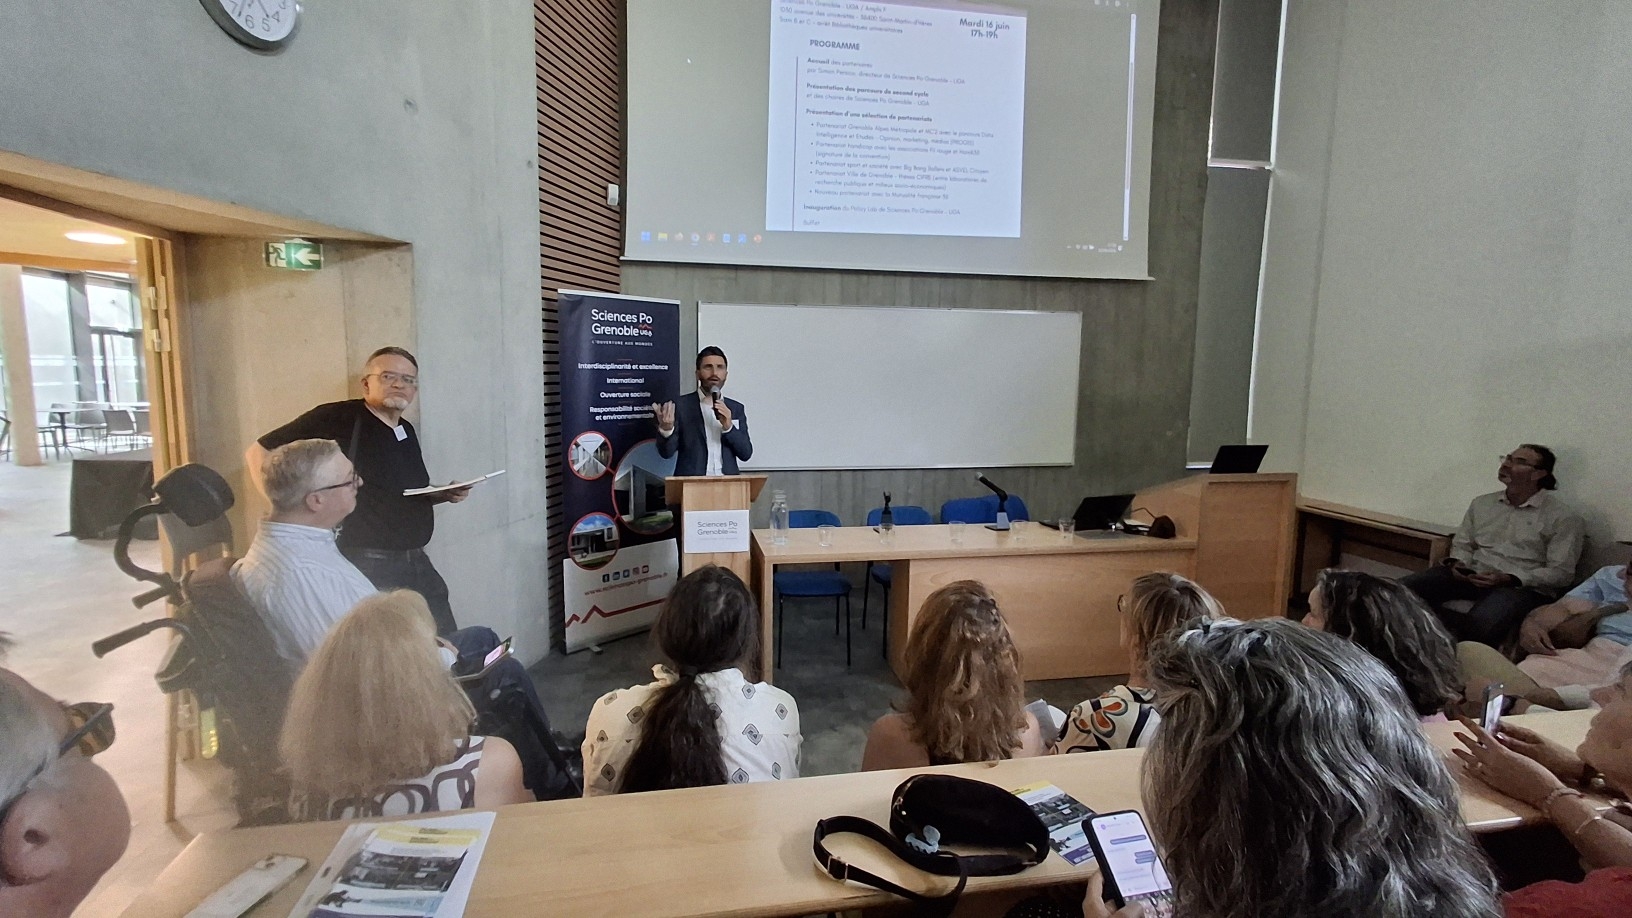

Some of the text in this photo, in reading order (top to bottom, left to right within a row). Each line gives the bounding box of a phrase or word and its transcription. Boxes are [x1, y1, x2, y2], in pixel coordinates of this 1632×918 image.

[245, 15, 254, 29] 6
[272, 11, 280, 22] 4
[262, 18, 270, 32] 5
[959, 17, 1009, 33] Mardi 16 juin
[971, 28, 998, 38] 17h-19h
[809, 38, 859, 50] PROGRAMME
[806, 82, 843, 90] Présentation
[806, 108, 843, 116] Présentation
[897, 114, 932, 123] partenariats
[803, 203, 841, 211] Inauguration
[592, 308, 652, 324] Sciences Po
[592, 324, 639, 336] Grenoble
